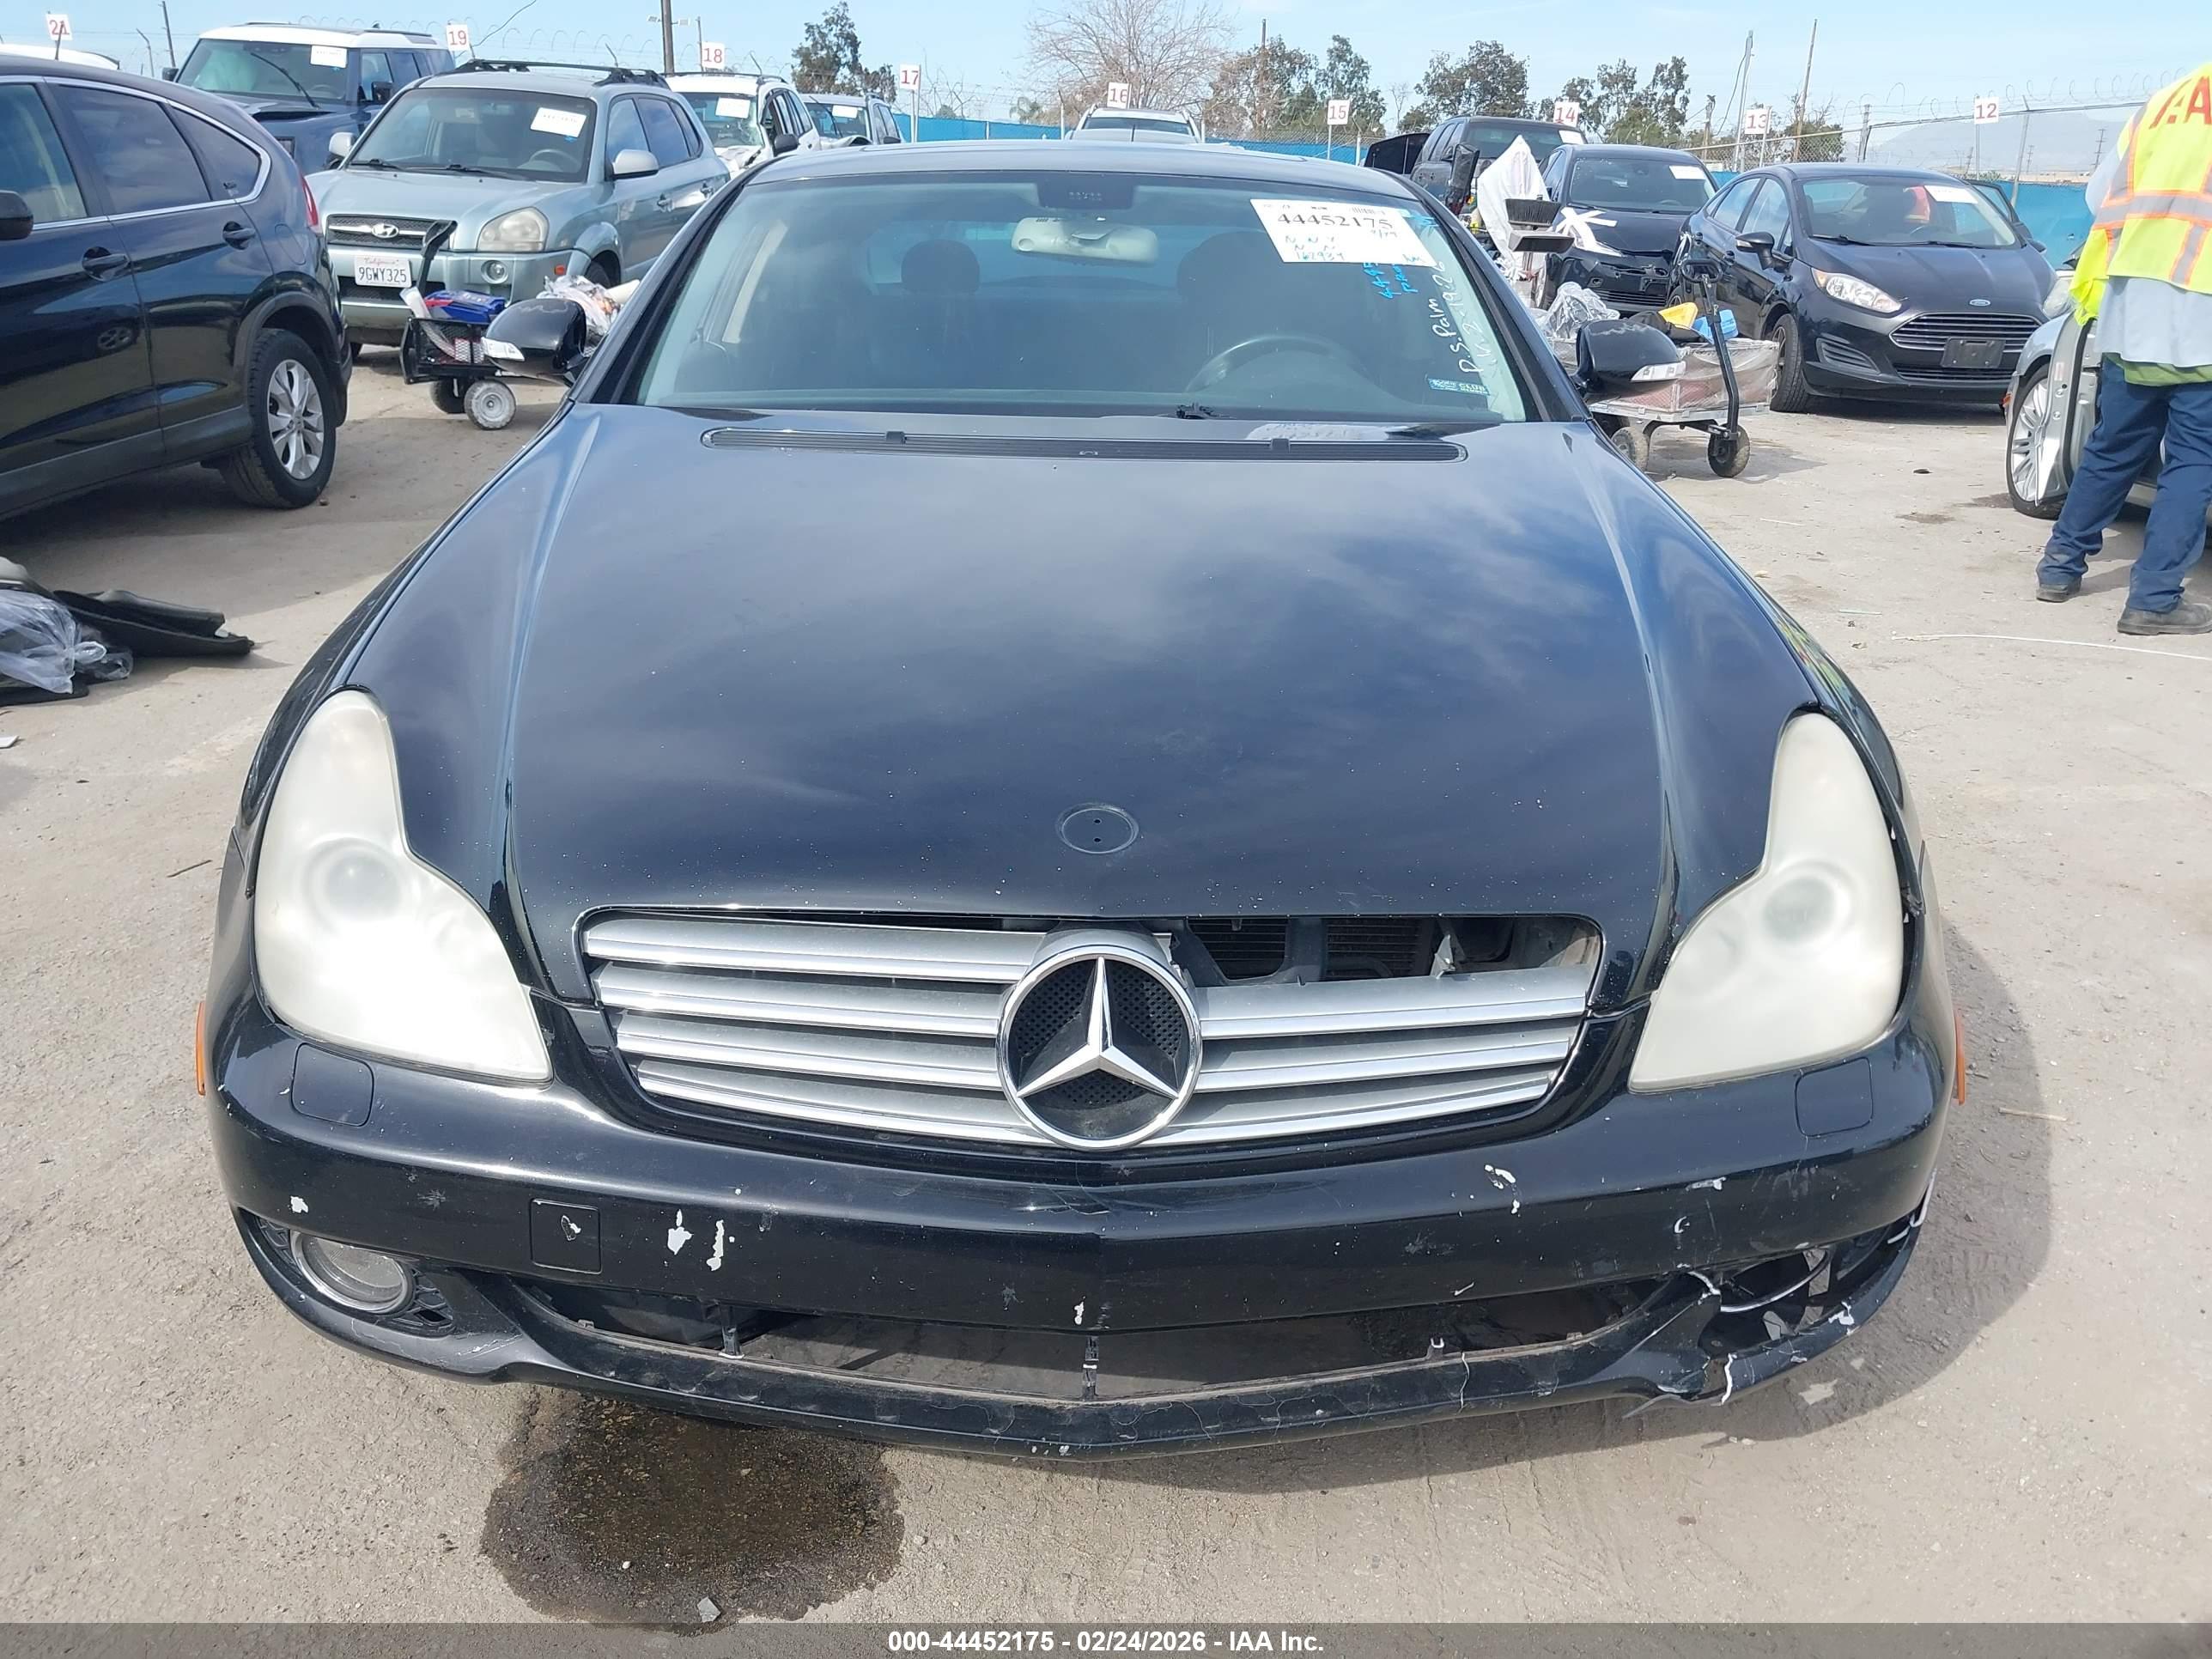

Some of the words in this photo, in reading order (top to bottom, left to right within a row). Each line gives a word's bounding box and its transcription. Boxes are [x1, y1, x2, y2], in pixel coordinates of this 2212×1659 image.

[49, 19, 70, 35] 21
[448, 29, 467, 46] 19
[703, 47, 723, 64] 18
[901, 70, 919, 85] 17
[1109, 88, 1127, 103] 16
[1328, 105, 1346, 119] 15
[1554, 106, 1576, 123] 14
[1975, 102, 1997, 119] 12
[1747, 113, 1767, 129] 13
[1277, 212, 1394, 229] 44452175
[358, 266, 407, 283] 9GWY325
